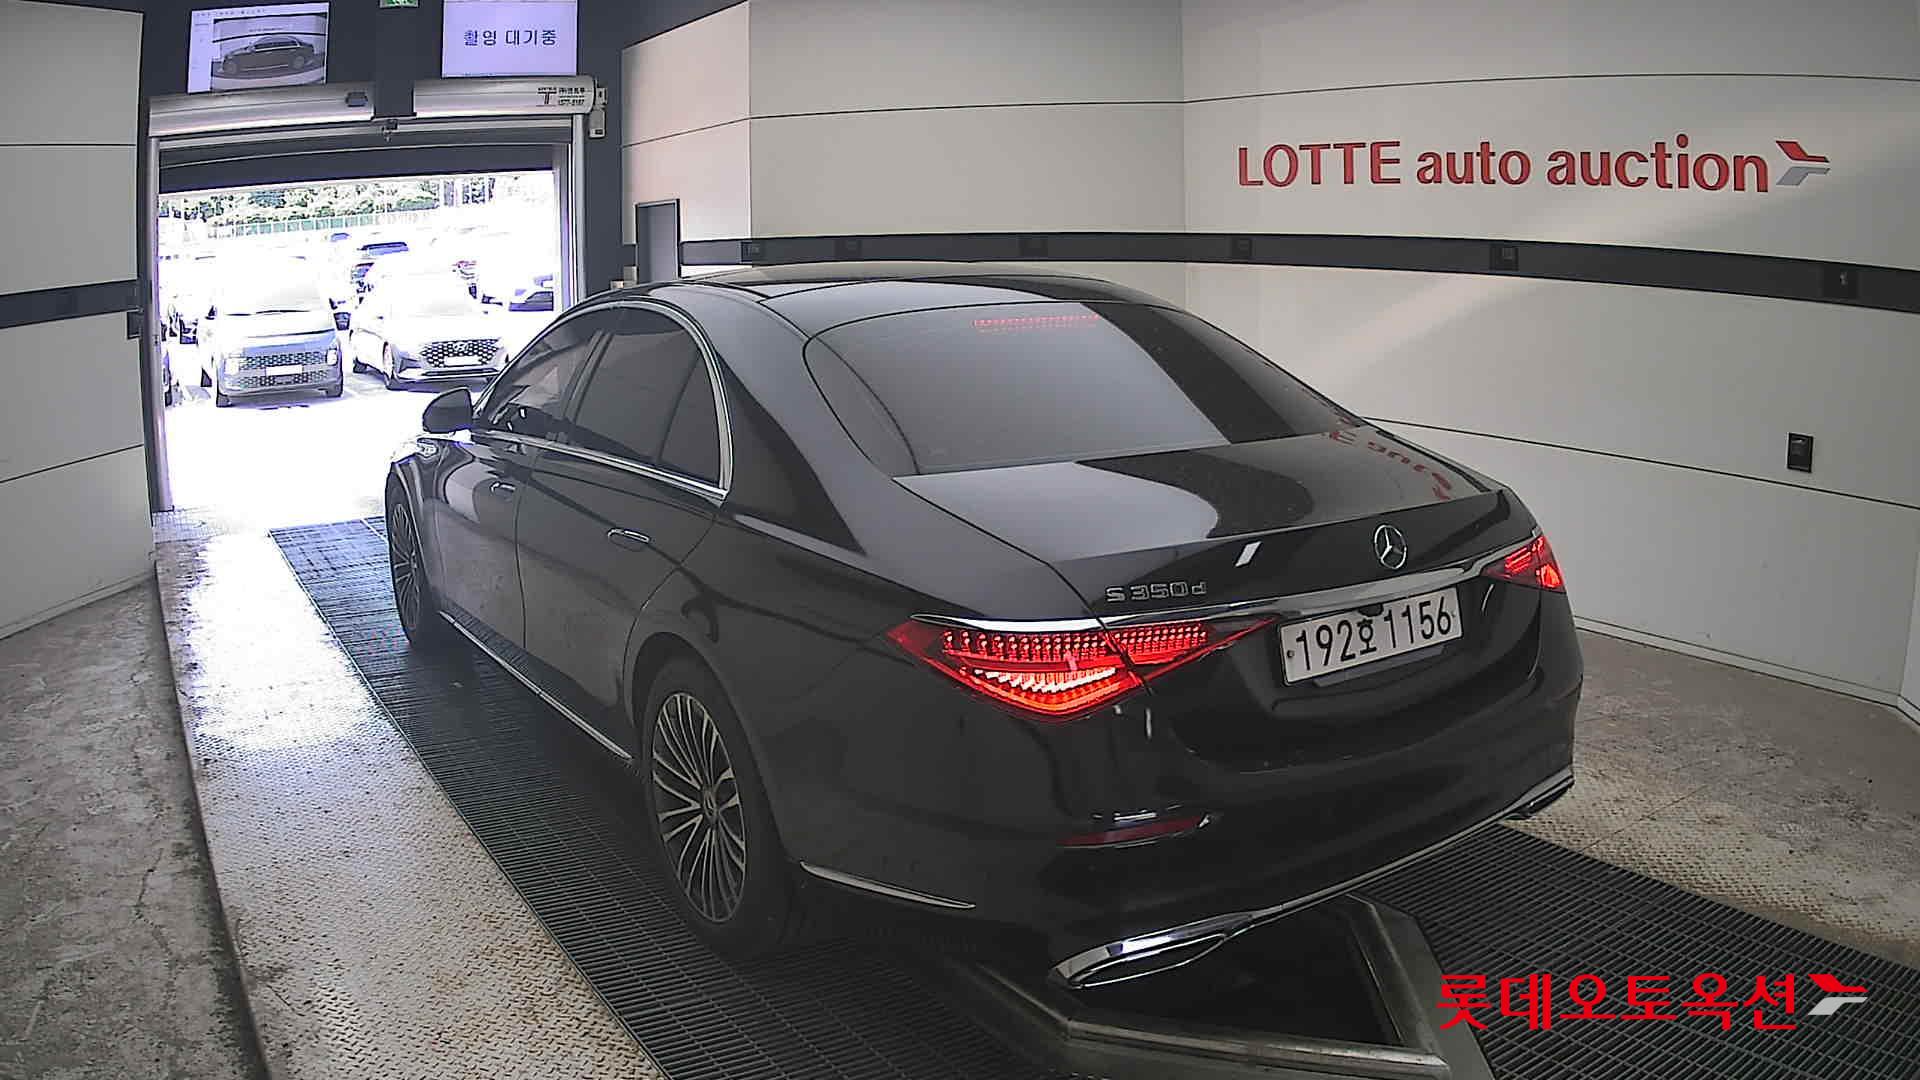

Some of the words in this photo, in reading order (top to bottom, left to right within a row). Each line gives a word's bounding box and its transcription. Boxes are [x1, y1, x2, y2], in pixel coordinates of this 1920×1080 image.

[505, 30, 556, 46] 대기중
[1238, 140, 1401, 187] LOTTE
[1416, 140, 1531, 185] auto
[1546, 133, 1769, 193] auction
